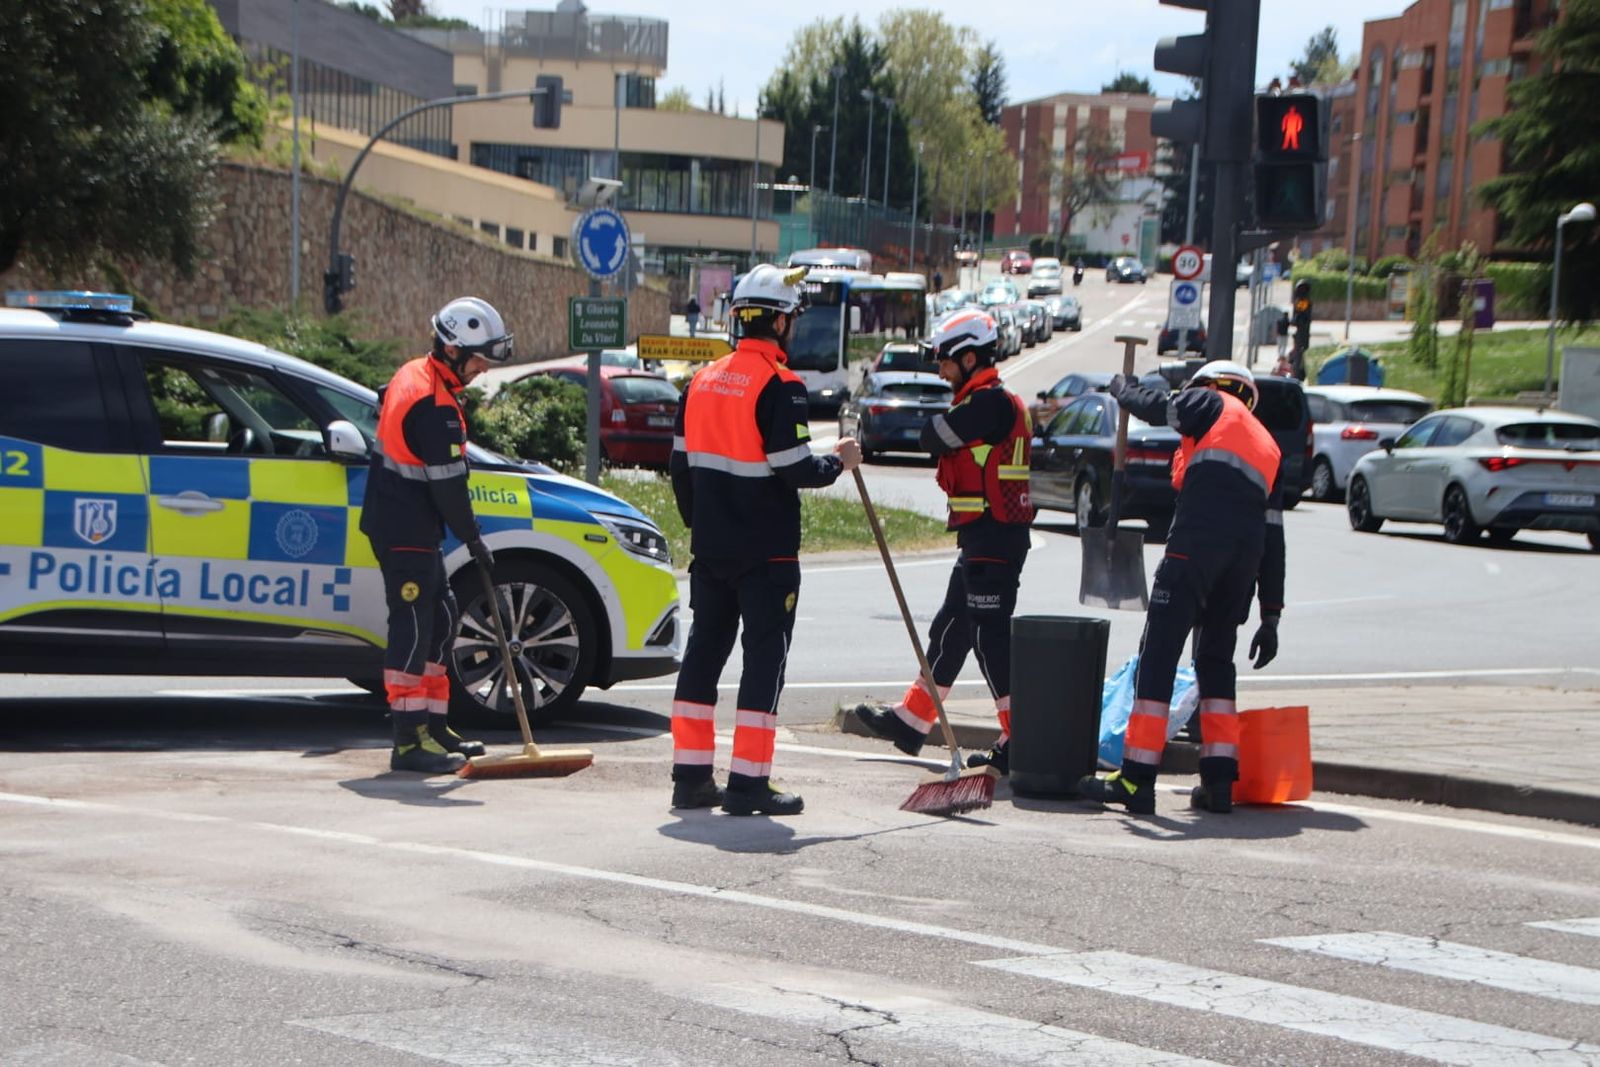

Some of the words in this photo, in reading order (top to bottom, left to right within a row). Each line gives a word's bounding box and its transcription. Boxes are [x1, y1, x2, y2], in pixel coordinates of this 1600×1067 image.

[444, 315, 459, 331] 23
[580, 318, 619, 329] Leonardo
[581, 332, 593, 344] Da
[594, 332, 617, 344] Vinci
[466, 484, 518, 505] olicía
[28, 551, 181, 599] Policía
[200, 562, 310, 608] Local
